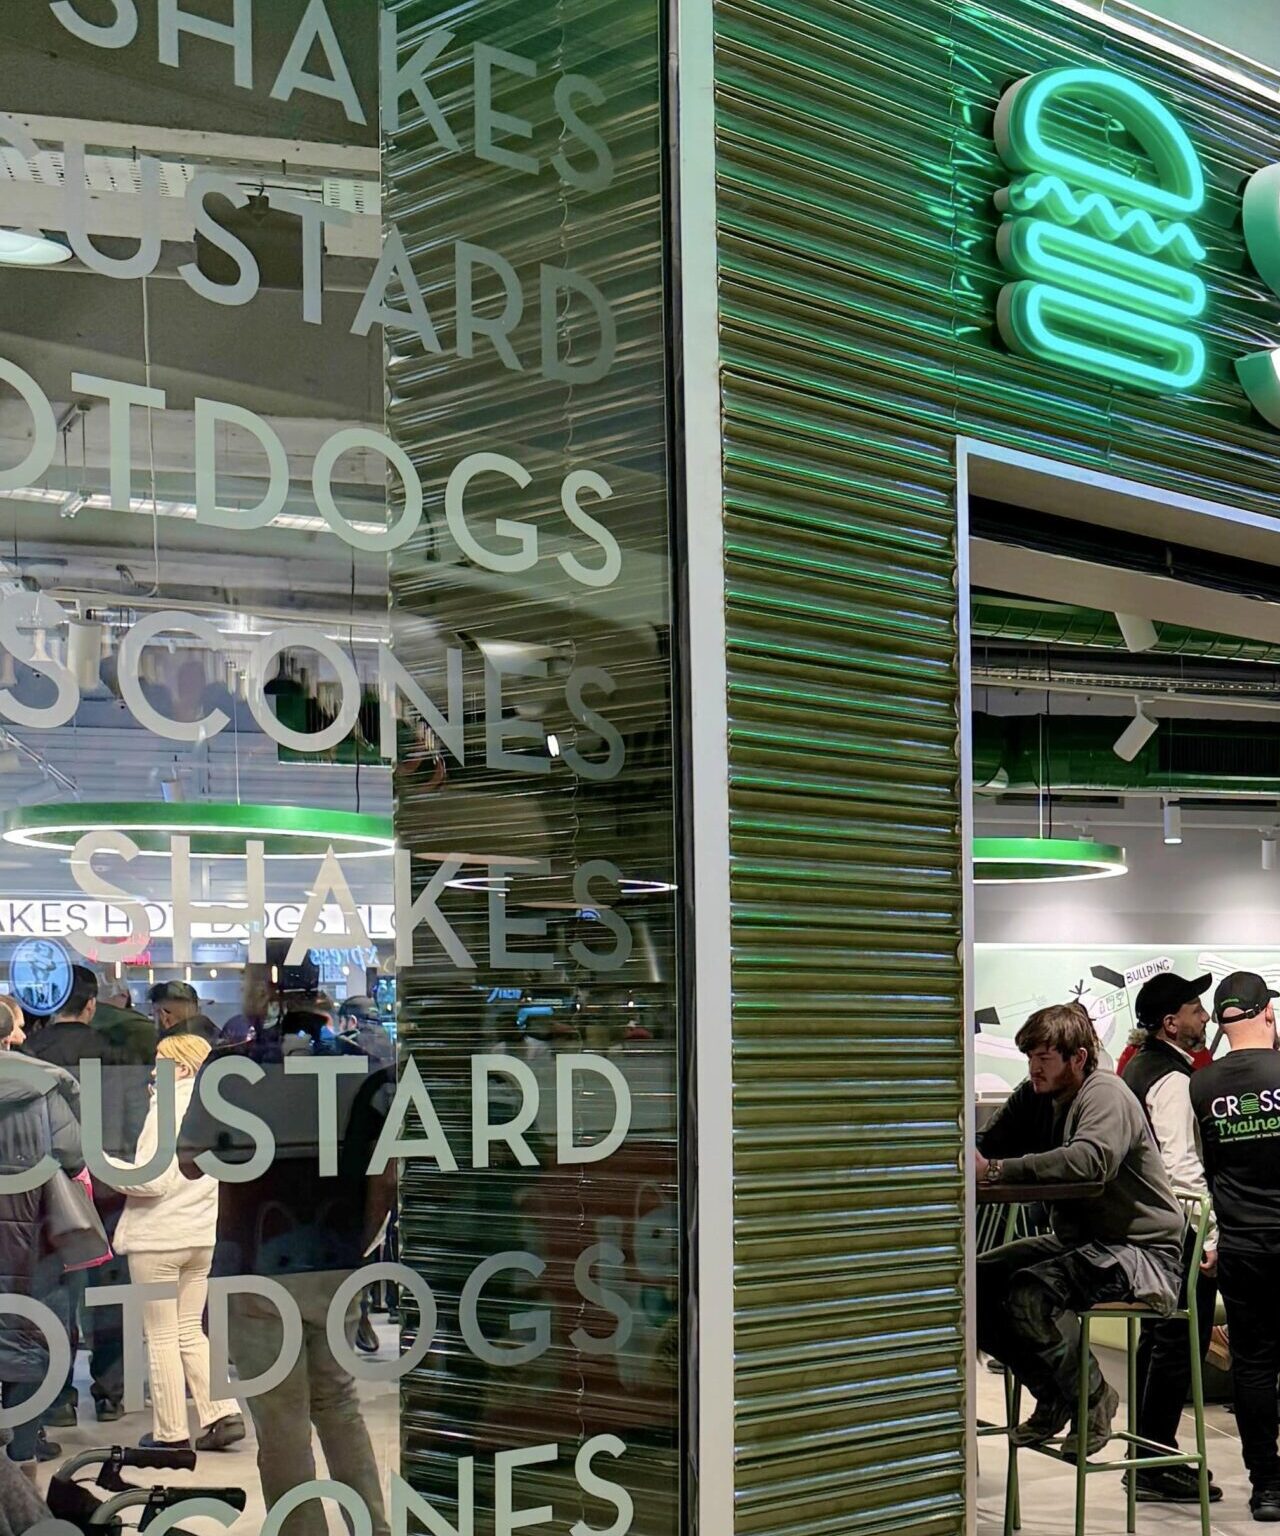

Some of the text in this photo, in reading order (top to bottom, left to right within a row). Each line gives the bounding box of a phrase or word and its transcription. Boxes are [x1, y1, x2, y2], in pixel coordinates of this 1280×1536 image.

[0, 115, 617, 385] USTARD
[0, 903, 88, 933] KES
[105, 903, 188, 933] HO
[66, 829, 634, 973] SHAKES
